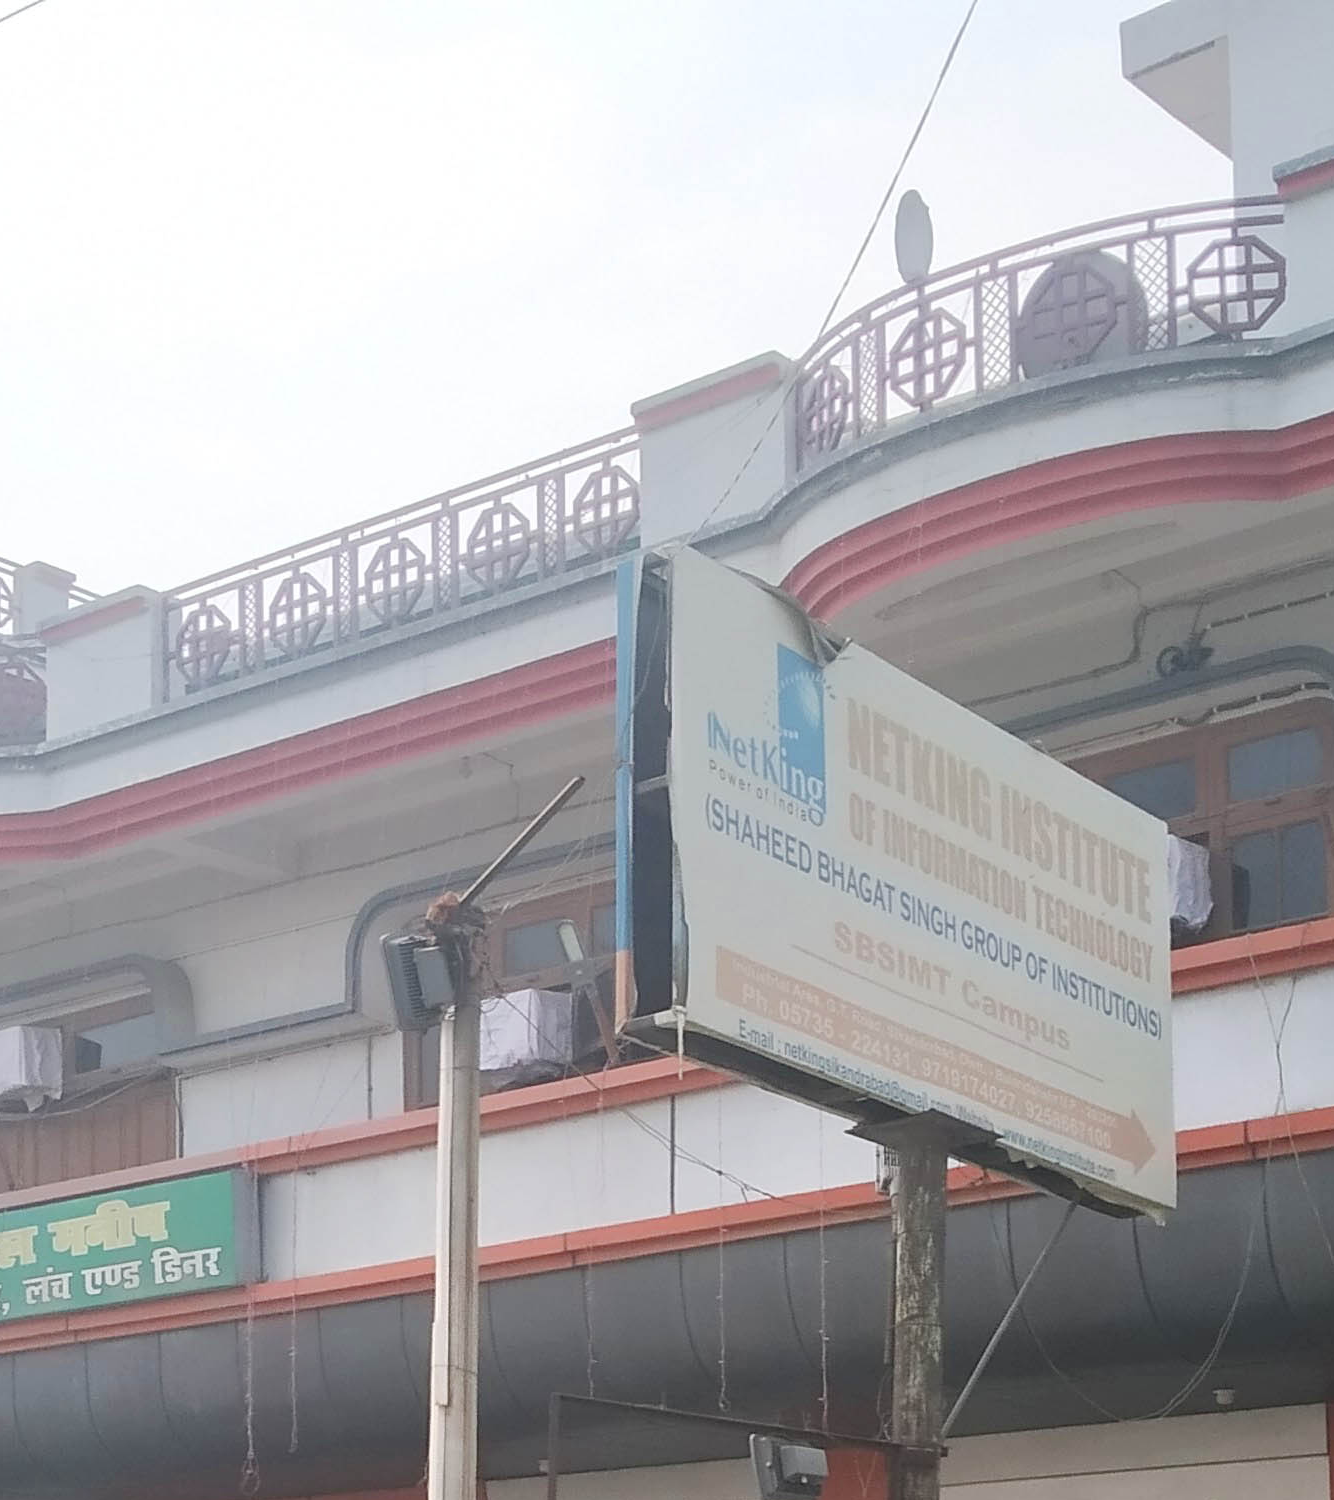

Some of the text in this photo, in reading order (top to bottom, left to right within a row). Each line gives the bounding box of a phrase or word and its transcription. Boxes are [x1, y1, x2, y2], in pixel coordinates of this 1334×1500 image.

[707, 711, 827, 827] NetKing
[709, 758, 752, 792] Power
[755, 785, 769, 801] of
[847, 697, 1153, 925] NETKING INSTITUTE
[705, 792, 1163, 1041] (SHAHEED BHAGAT SINGH GROUP OF INSTITUTIONS)
[849, 792, 1155, 985] OF INFORMATION TECHNOLOGY
[778, 1000, 835, 1040] 05735
[833, 919, 953, 997] SBSIMT
[960, 976, 1071, 1051] Campus
[22, 1266, 73, 1305] लंच
[80, 1260, 143, 1297] एण्ड
[151, 1246, 222, 1286] डिनर
